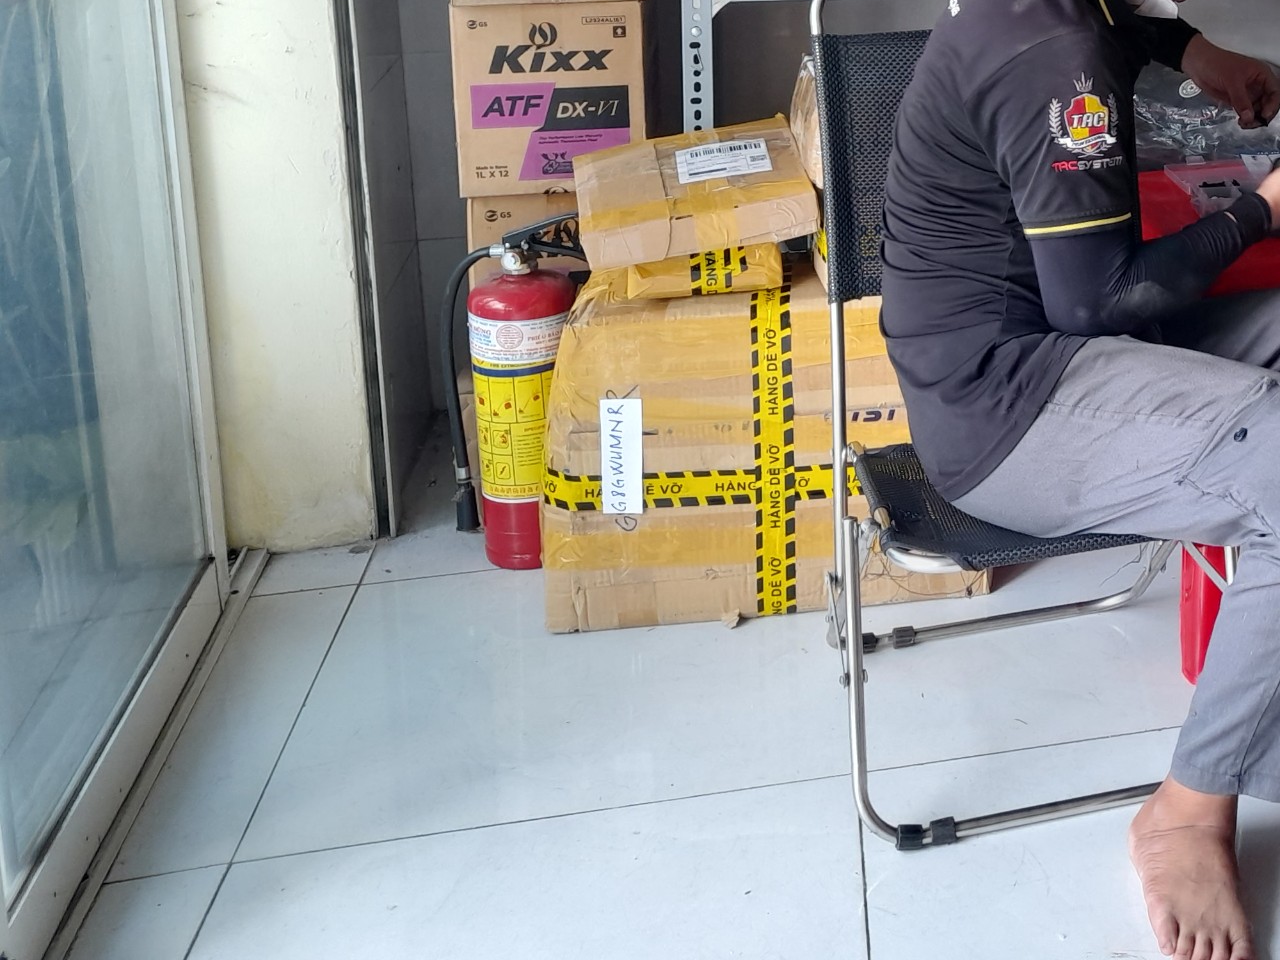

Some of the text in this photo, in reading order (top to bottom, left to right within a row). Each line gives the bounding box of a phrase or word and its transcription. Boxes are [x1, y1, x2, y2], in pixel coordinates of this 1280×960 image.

[489, 44, 614, 74] Kixx
[482, 95, 620, 118] ATF DX-VI
[1071, 112, 1105, 129] TAC
